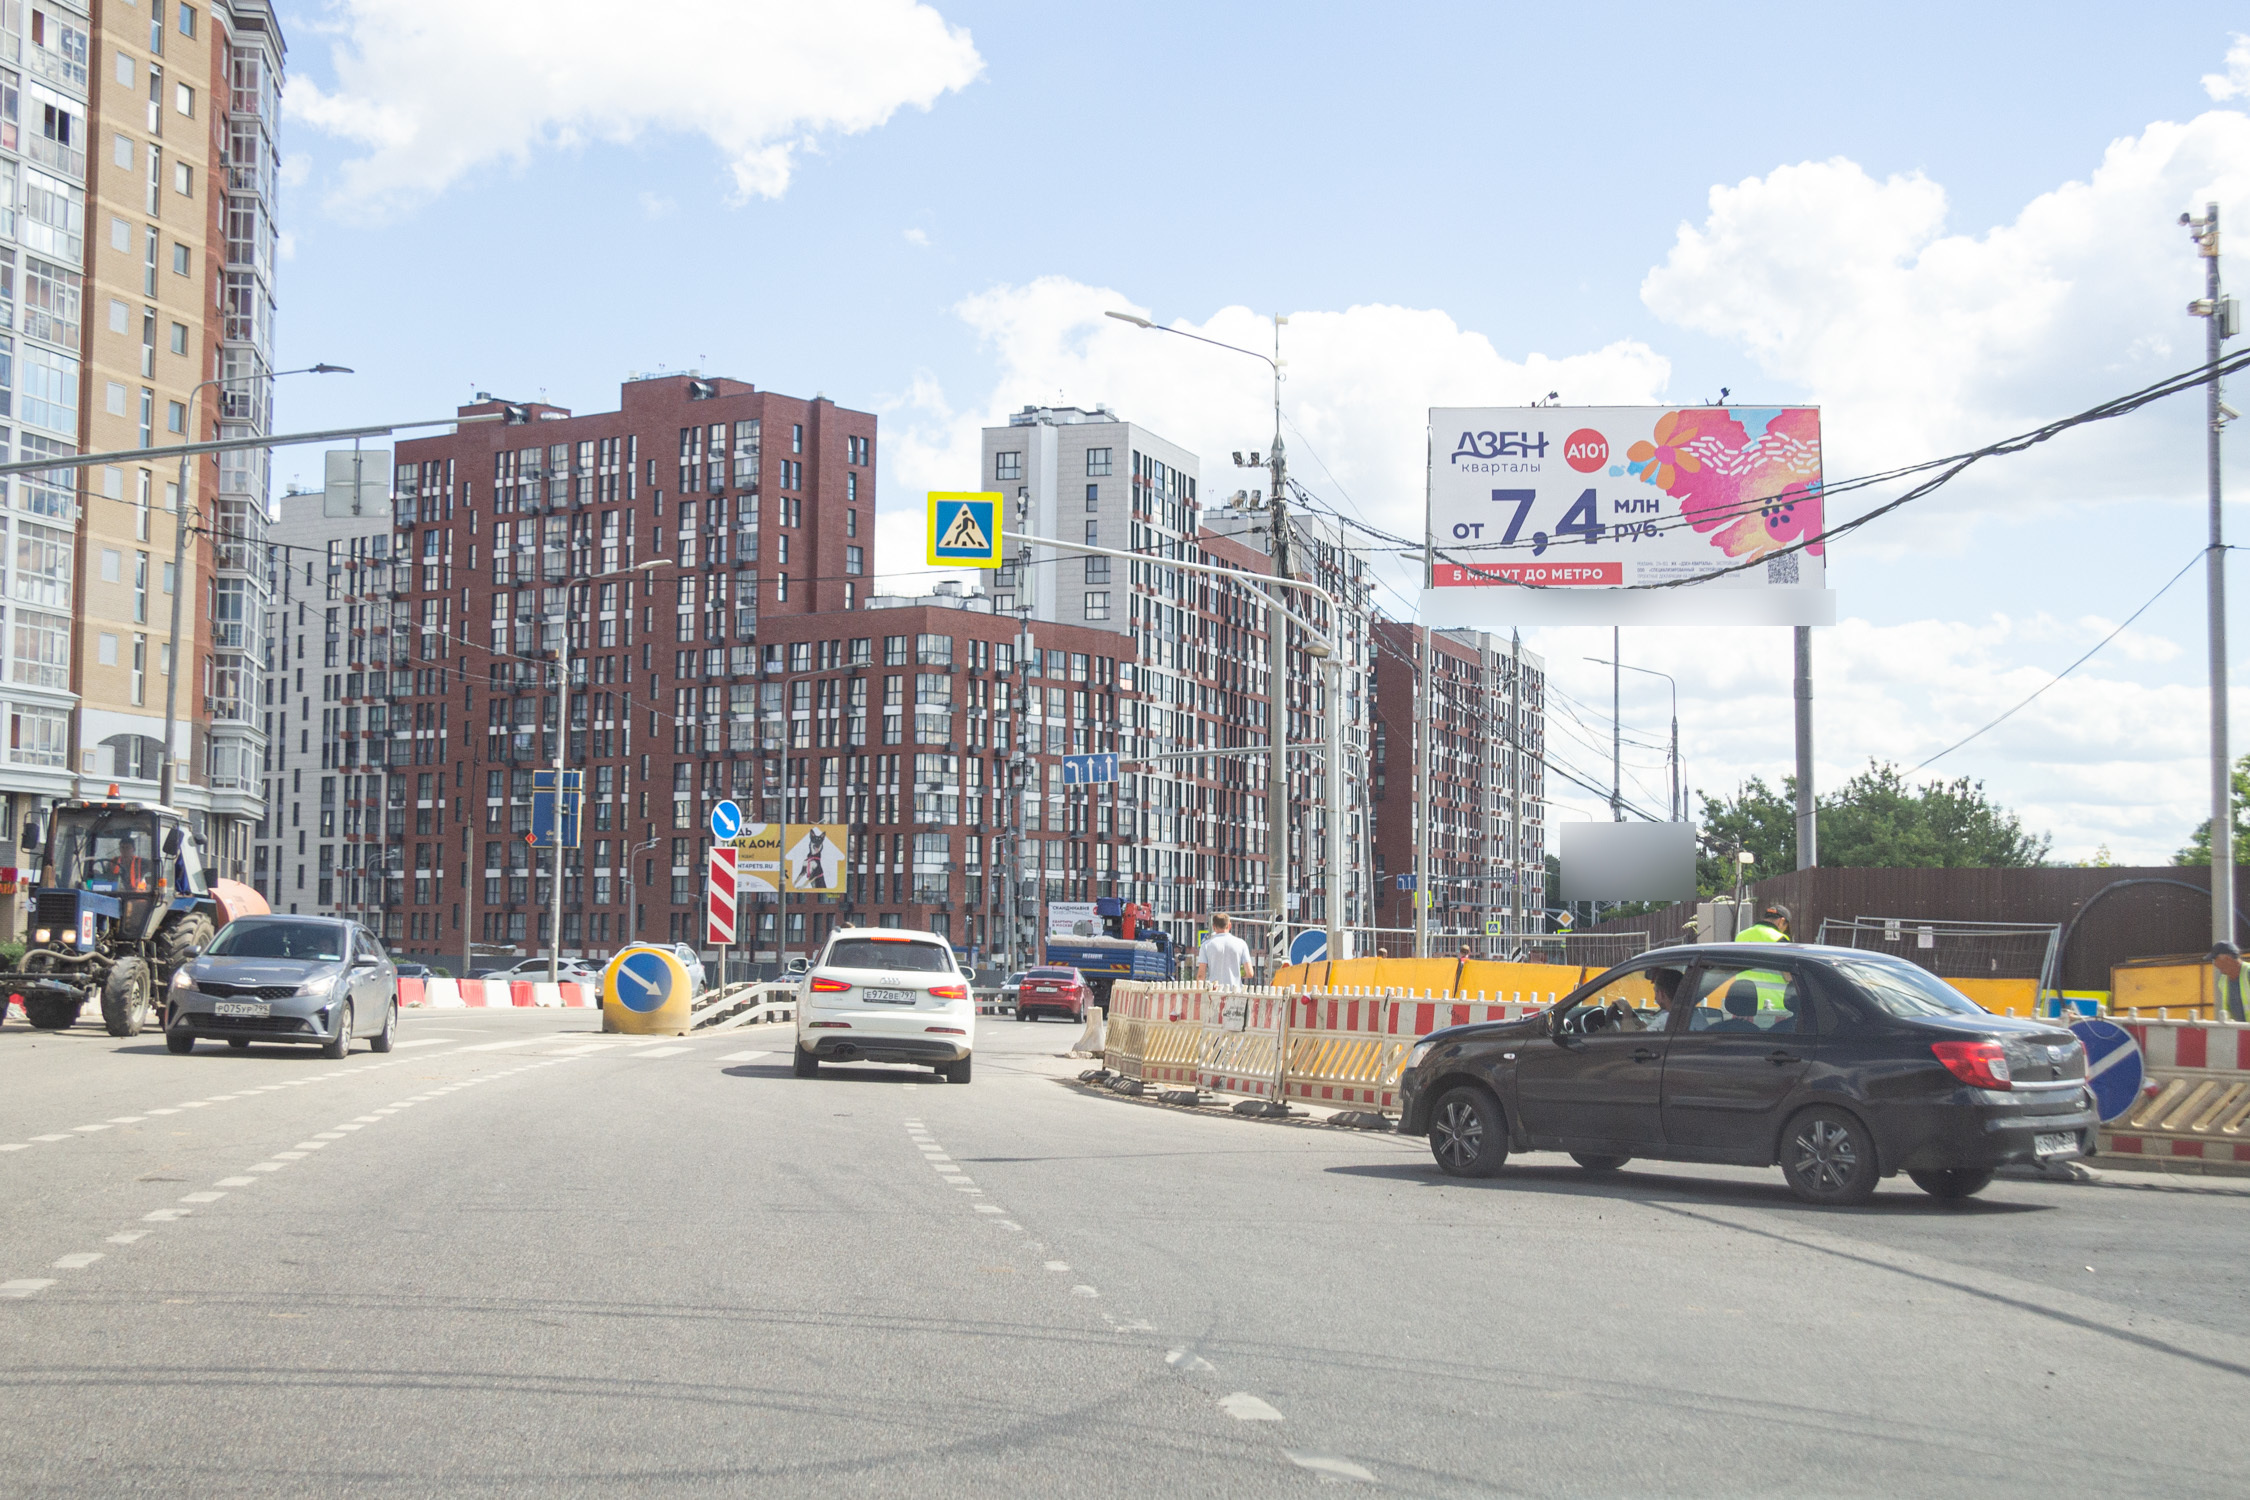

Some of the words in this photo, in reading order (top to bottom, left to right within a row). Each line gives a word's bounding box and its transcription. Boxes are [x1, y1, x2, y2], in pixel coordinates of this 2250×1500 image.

[1452, 431, 1549, 464] ДЗЕН
[1567, 443, 1606, 458] А101
[1462, 463, 1540, 476] кварталы
[1614, 499, 1659, 513] млн
[1452, 523, 1484, 539] от
[1492, 489, 1605, 557] 7,4
[1614, 522, 1664, 543] руб.
[1453, 570, 1462, 581] 5
[1467, 569, 1520, 581] МИНУТ
[1525, 569, 1547, 581] ДО
[1552, 568, 1603, 580] МЕТРО
